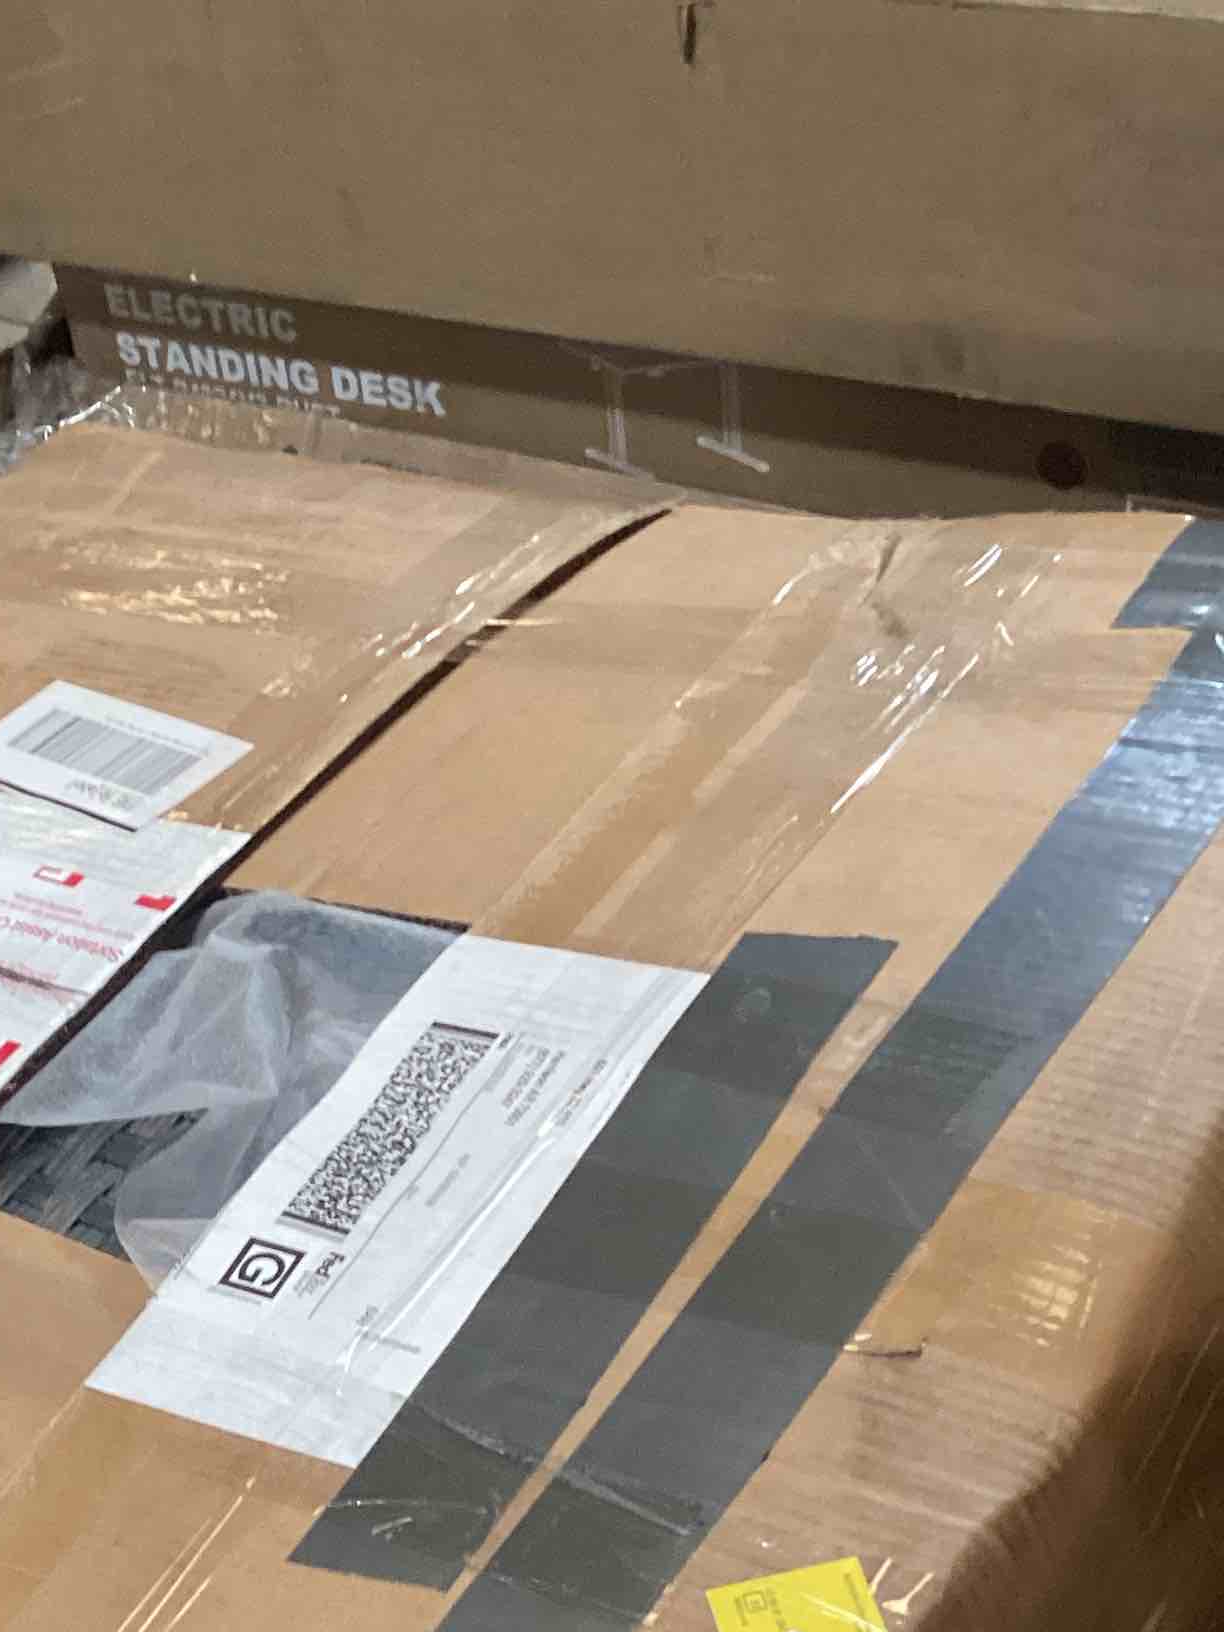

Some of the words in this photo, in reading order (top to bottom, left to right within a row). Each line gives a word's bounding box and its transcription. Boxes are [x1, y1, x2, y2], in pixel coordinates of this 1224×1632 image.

[104, 283, 296, 343] ELECTRIC
[116, 331, 320, 395] STANDING
[331, 365, 447, 417] DESK
[237, 1252, 287, 1287] G
